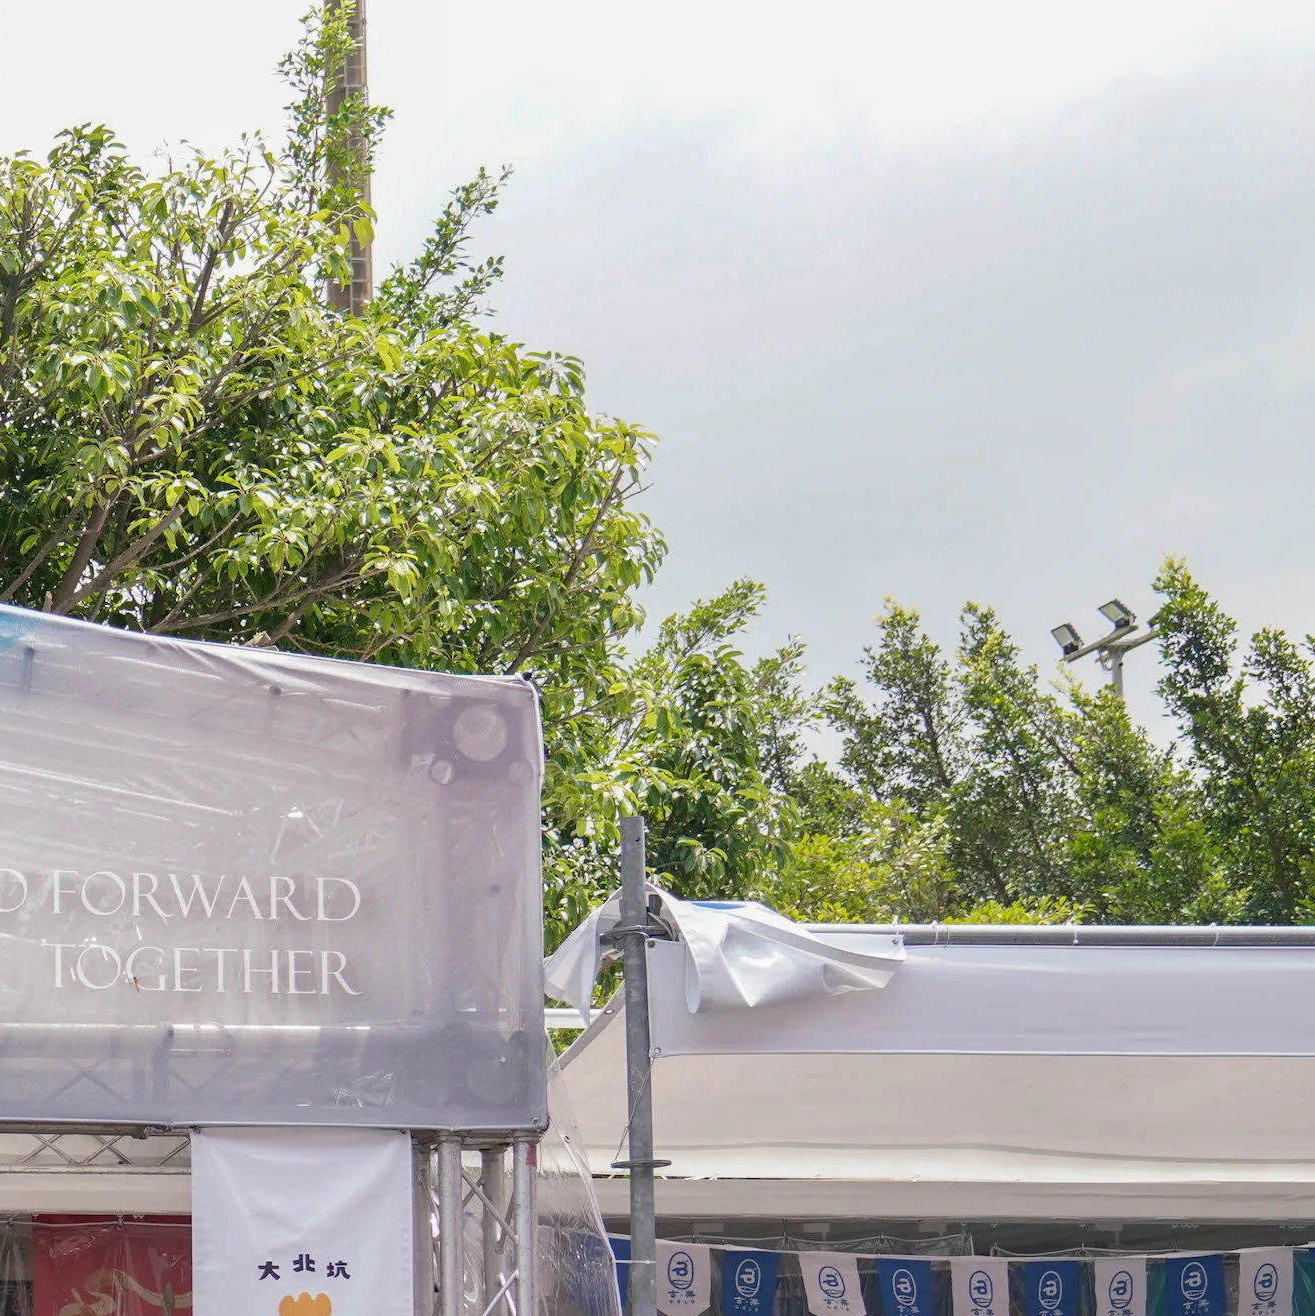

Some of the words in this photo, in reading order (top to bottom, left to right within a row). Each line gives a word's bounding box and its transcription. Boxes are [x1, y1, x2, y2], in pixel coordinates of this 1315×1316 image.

[51, 869, 362, 924] FORWARD
[41, 942, 363, 996] TOGETHER
[258, 1253, 352, 1281] 大北坑
